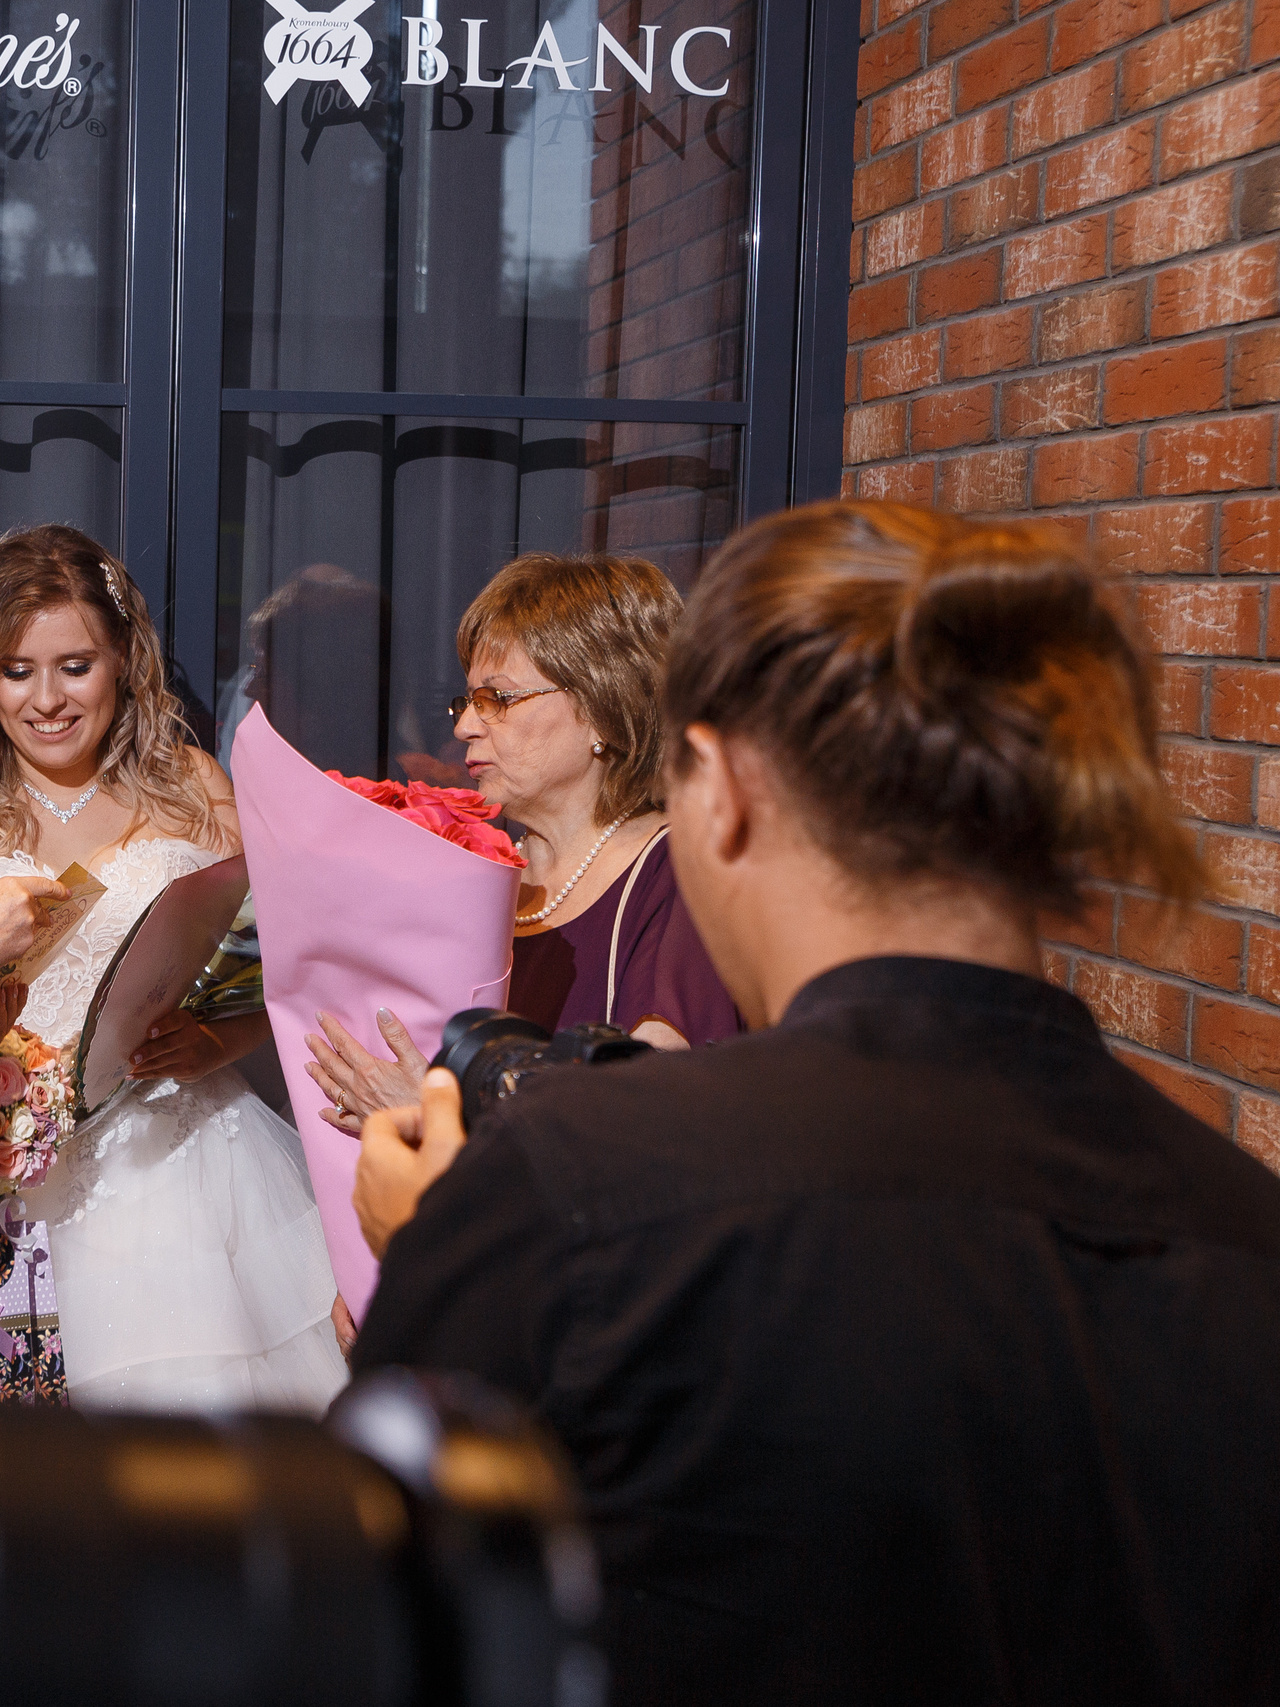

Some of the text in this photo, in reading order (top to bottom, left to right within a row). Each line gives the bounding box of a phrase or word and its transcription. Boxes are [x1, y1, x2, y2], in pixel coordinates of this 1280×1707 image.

[289, 17, 350, 31] Kronenbourg
[277, 28, 358, 70] 1664
[401, 16, 731, 97] BLANC
